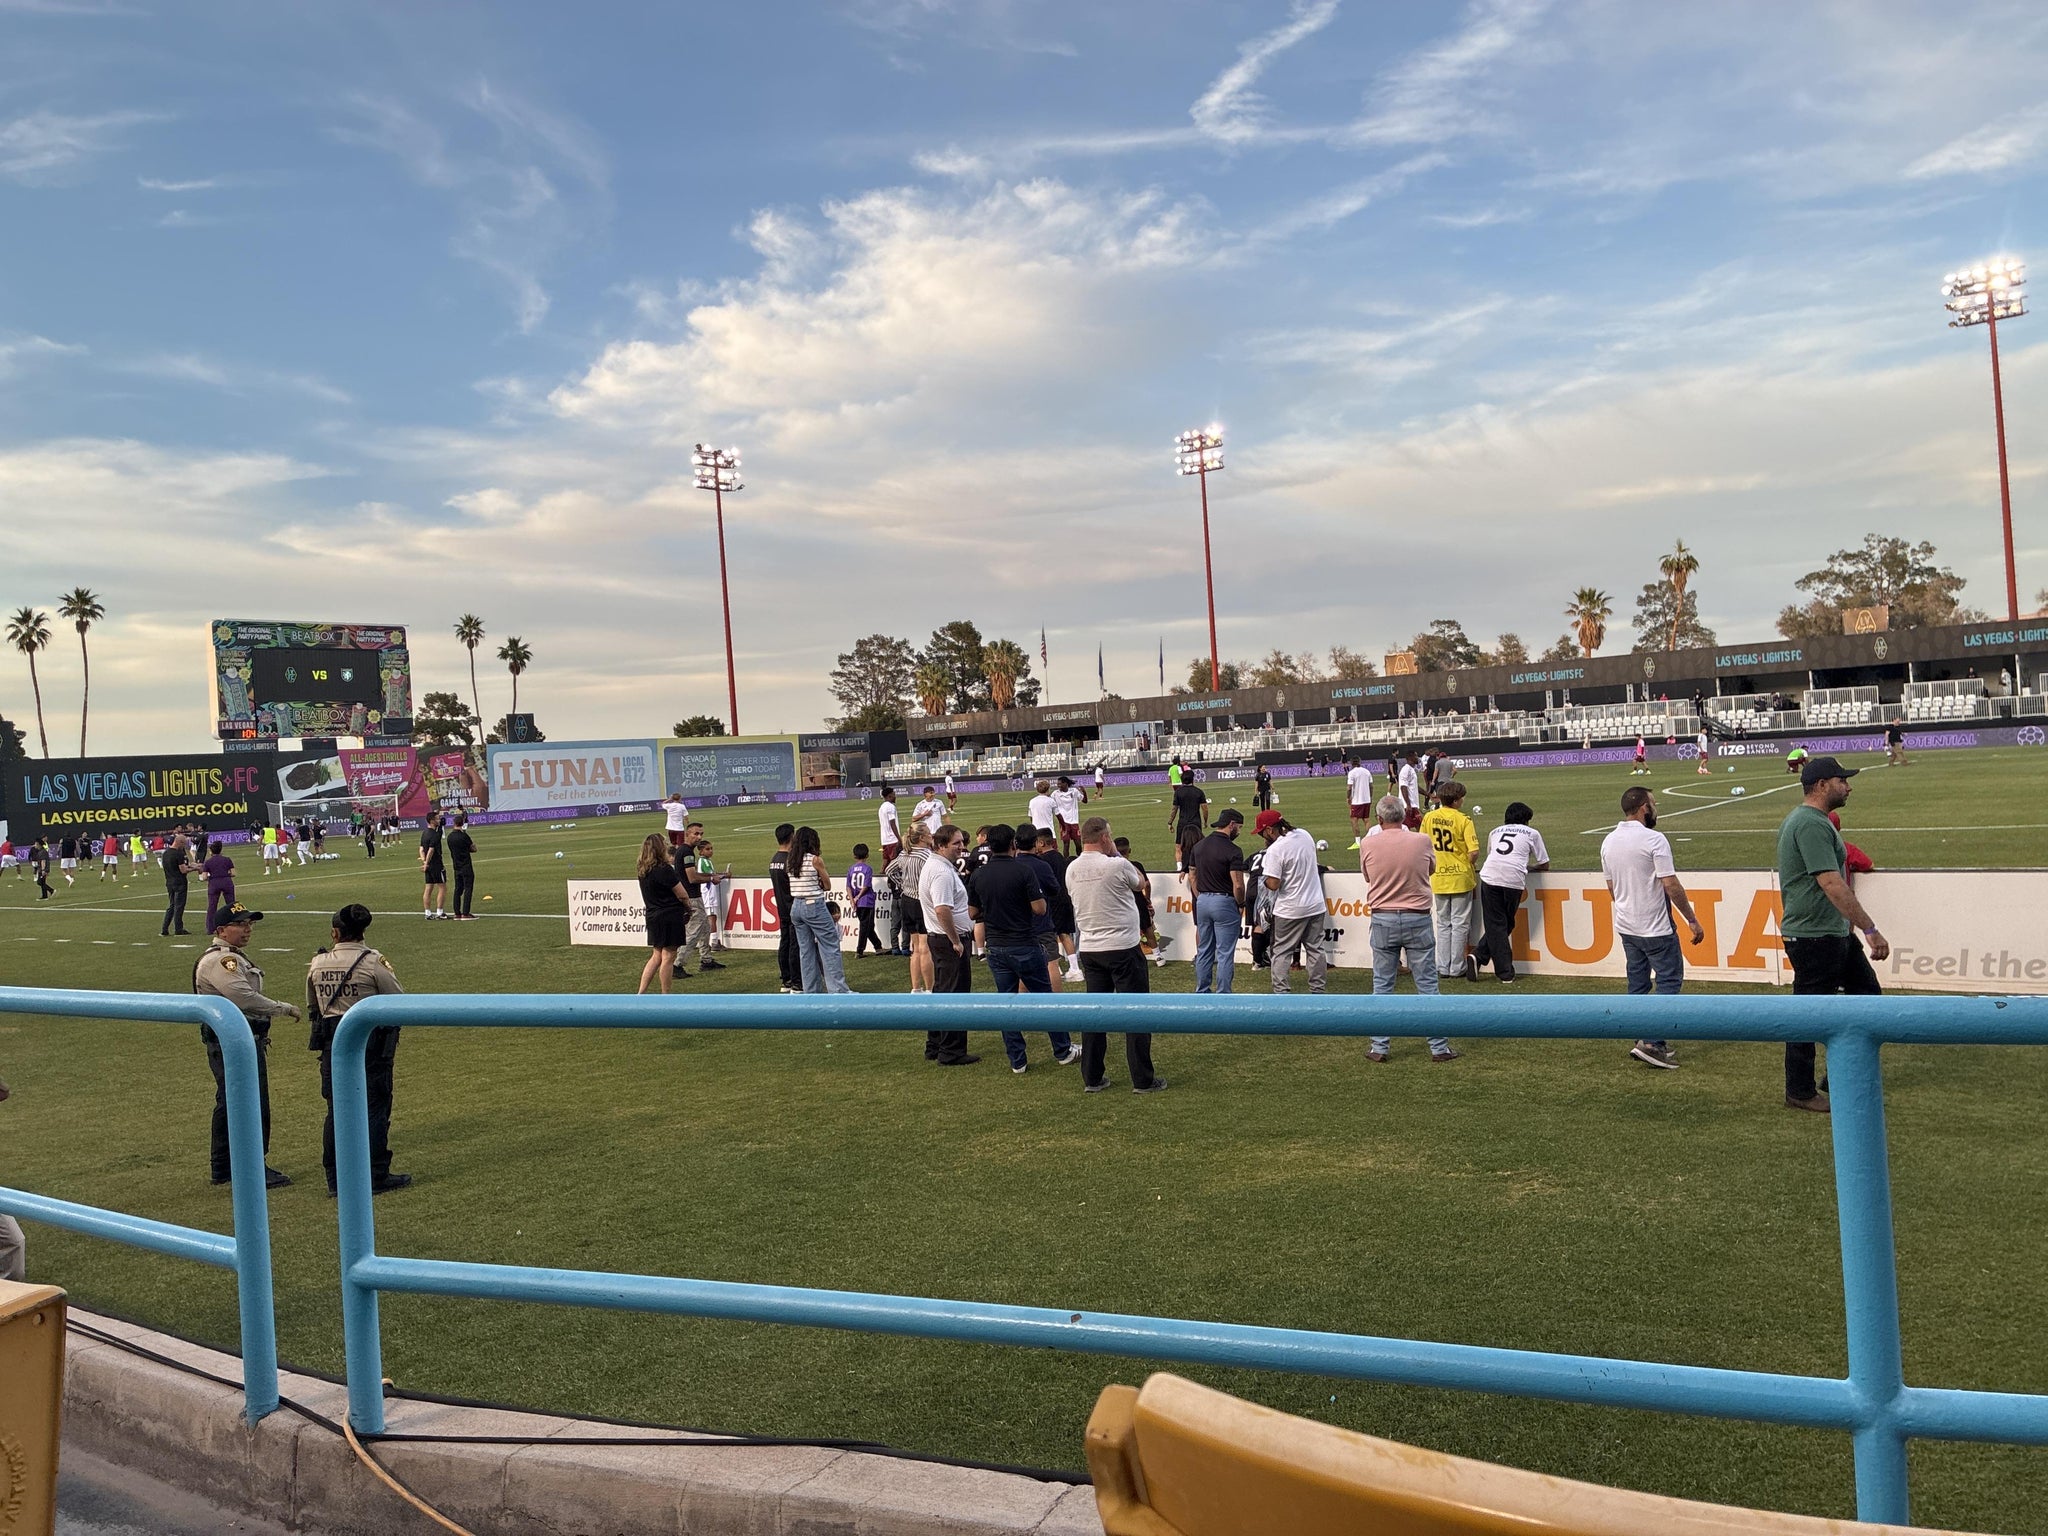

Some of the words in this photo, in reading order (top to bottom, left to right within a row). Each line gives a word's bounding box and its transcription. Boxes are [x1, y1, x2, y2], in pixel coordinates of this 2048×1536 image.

[291, 631, 335, 641] BEATBOX
[1964, 634, 1983, 647] LAS
[1983, 631, 2014, 645] VEGAS
[1716, 656, 1731, 667] LAS
[1731, 653, 1758, 665] VEGAS
[1762, 651, 1790, 664] LIGHTS
[1791, 649, 1802, 661] FC
[312, 670, 328, 680] VS
[1511, 674, 1524, 684] LAS
[1525, 672, 1547, 683] VEGAS
[1550, 670, 1574, 681] LIGHTS
[1575, 669, 1585, 679] FC
[1331, 690, 1342, 698] LAS
[1343, 688, 1362, 697] VEGAS
[1365, 686, 1386, 696] LIGHTS
[1387, 685, 1395, 694] FC
[1177, 702, 1187, 711] LAS
[1187, 701, 1204, 710] VEGAS
[1206, 699, 1224, 709] LIGHTS
[1224, 698, 1232, 707] FC
[294, 708, 346, 721] BEATBOX
[1042, 713, 1052, 722] LAS
[1052, 712, 1067, 721] VEGAS
[1068, 711, 1084, 720] LIGHTS
[1084, 710, 1091, 718] FC
[926, 723, 934, 731] LAS
[933, 722, 947, 731] VEGAS
[962, 720, 969, 729] FC
[803, 739, 817, 747] LAS
[817, 738, 840, 747] VEGAS
[841, 737, 865, 746] LIGHTS
[1850, 737, 1887, 750] YOU
[1901, 734, 1977, 749] OTENTIAL
[1718, 742, 1746, 756] rize
[350, 753, 380, 763] ALL-AGES
[382, 751, 408, 761] THRILLS
[622, 756, 645, 766] LOCAL
[681, 755, 710, 763] NEVADA
[723, 757, 758, 766] REGISTER
[760, 756, 769, 764] TO
[1501, 754, 1544, 767] REALIZE
[1546, 752, 1579, 764] YOUR
[1582, 750, 1640, 762] POTENTIA
[681, 762, 710, 770] DONOR
[732, 766, 753, 774] HERO
[754, 764, 780, 773] TODAY!
[498, 757, 622, 791] LiUNA!
[623, 767, 646, 784] 872
[682, 769, 718, 778] NETWORK
[1217, 768, 1236, 779] rize
[24, 774, 69, 804] LAS
[73, 771, 147, 801] VEGAS
[150, 768, 223, 797] LIGHTS
[234, 766, 259, 793] FC
[448, 789, 472, 797] FAMILY
[547, 790, 567, 800] Feel
[570, 789, 586, 799] the
[588, 787, 622, 799] Power!
[440, 799, 459, 807] GAME
[41, 802, 248, 826] LASVEGASLIGHTSFC.COM
[1432, 828, 1454, 853] 32
[1496, 833, 1517, 856] 5
[580, 891, 588, 900] IT
[589, 890, 622, 901] Services
[581, 906, 601, 916] VOIP
[602, 905, 627, 916] Phone
[724, 888, 781, 933] AIS
[582, 921, 613, 931] Camera
[614, 922, 621, 931] &
[1891, 947, 1969, 977] Feel
[1980, 950, 2047, 979] the
[321, 971, 353, 982] METRO
